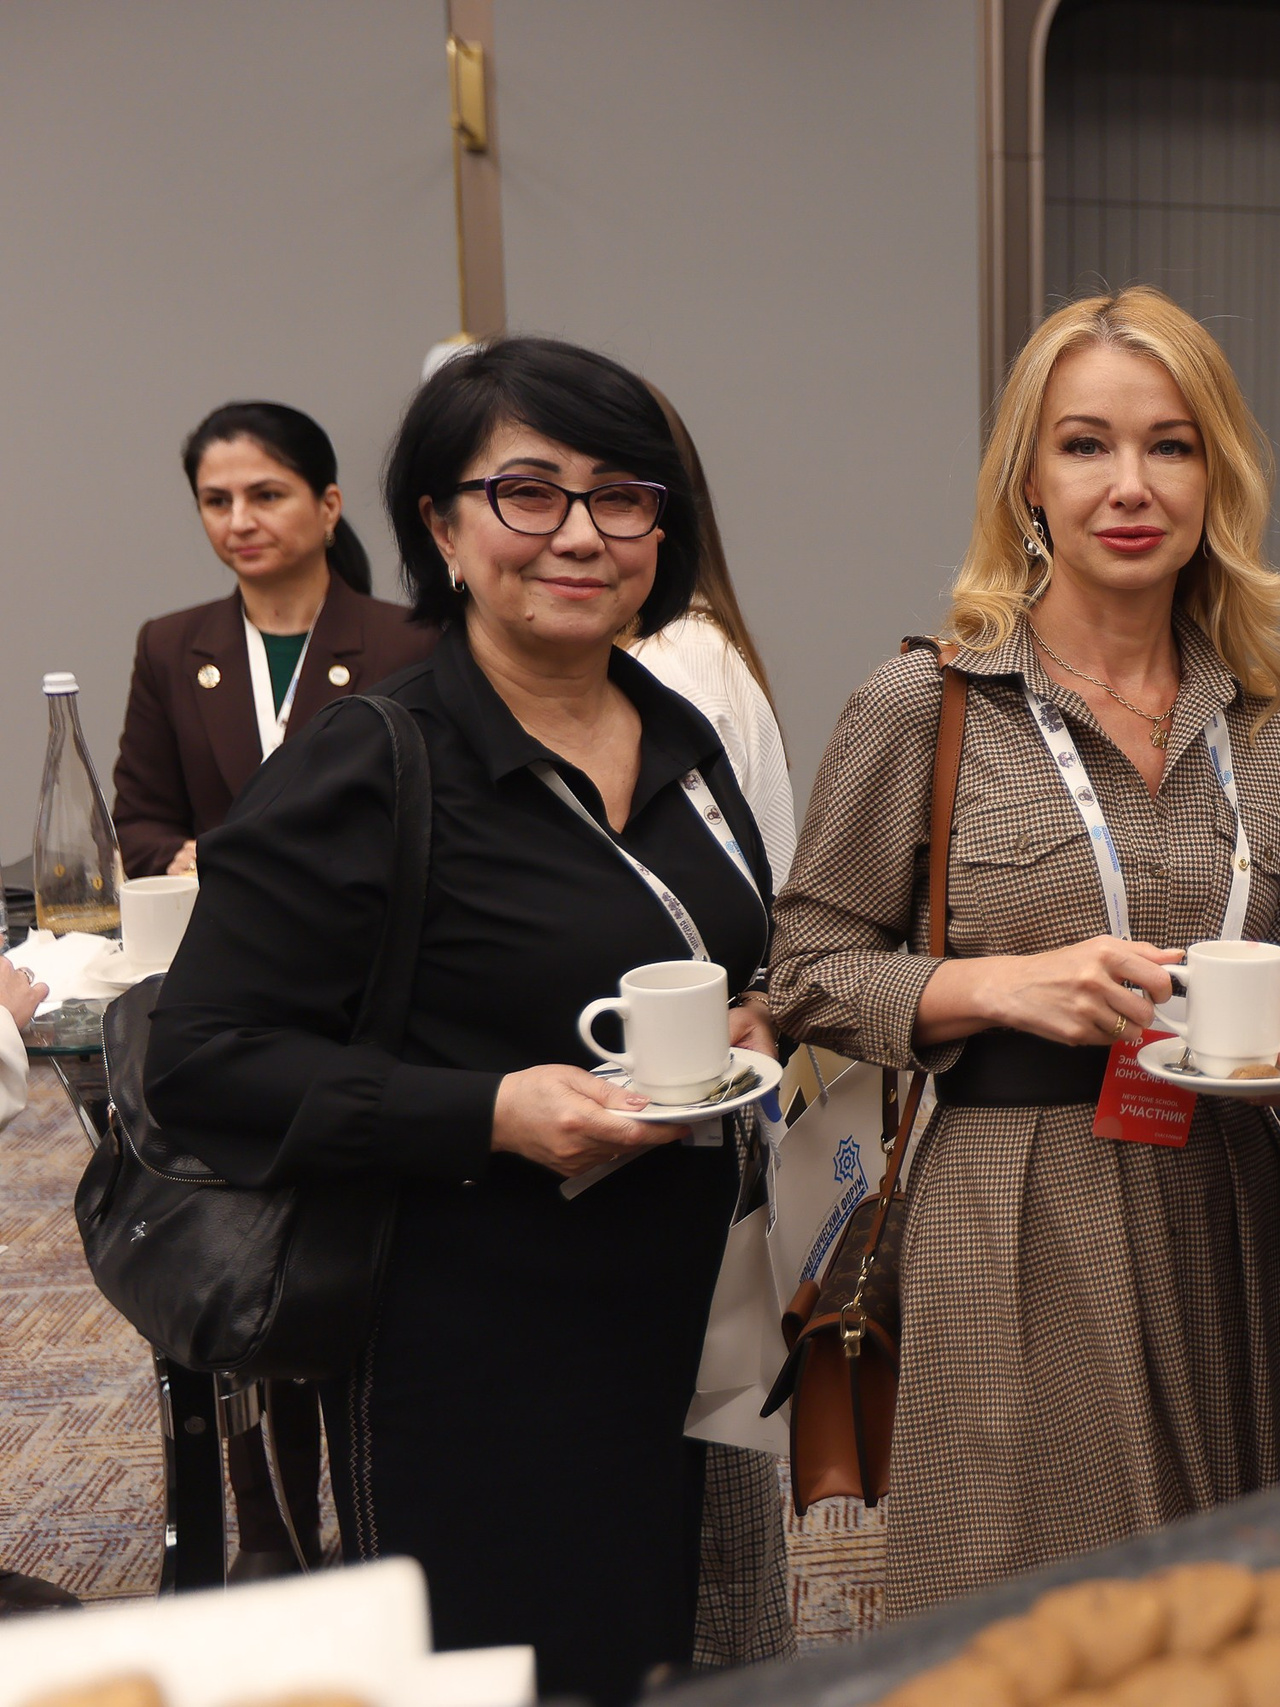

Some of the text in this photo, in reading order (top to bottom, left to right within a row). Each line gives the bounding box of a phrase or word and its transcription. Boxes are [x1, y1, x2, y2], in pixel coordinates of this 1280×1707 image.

[1118, 1055, 1140, 1067] Эли
[1122, 1093, 1179, 1107] NEW TONE SCHOOL
[1119, 1103, 1187, 1124] УЧАСТНИК
[841, 1175, 865, 1210] ФОРУМ
